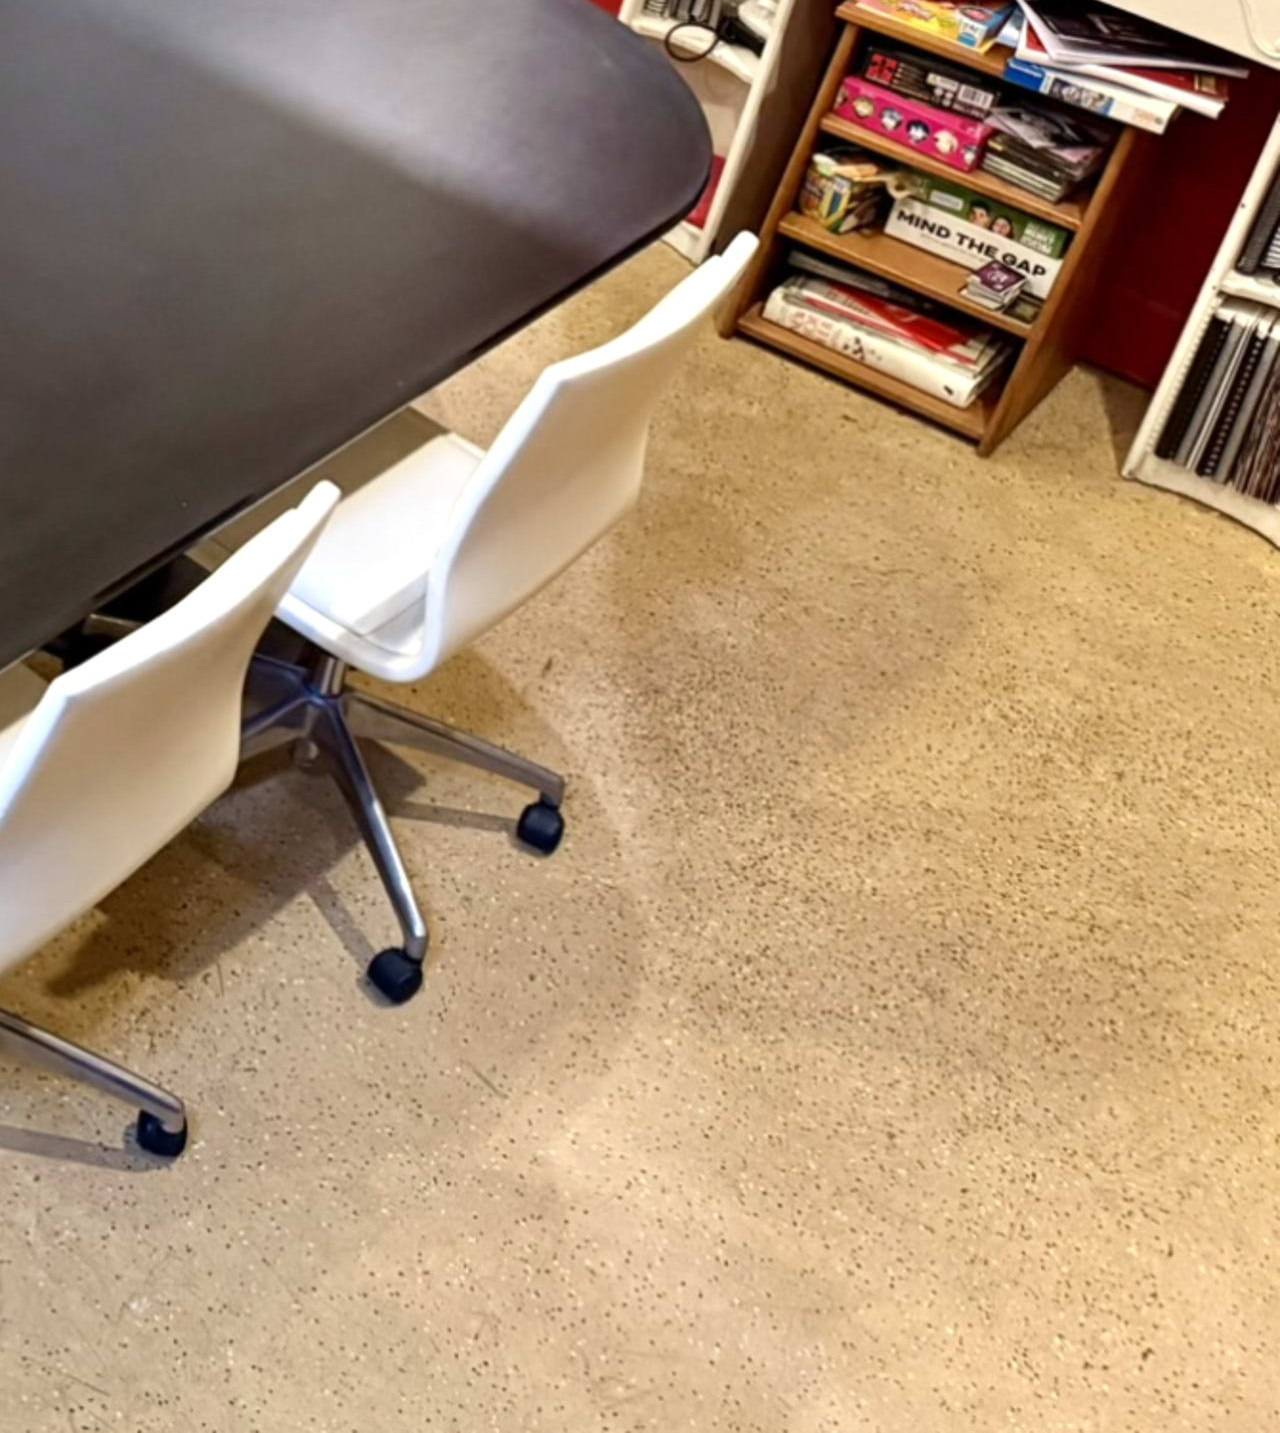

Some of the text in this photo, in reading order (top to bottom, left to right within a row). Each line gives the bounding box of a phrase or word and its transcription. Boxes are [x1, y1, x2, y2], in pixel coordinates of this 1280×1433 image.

[896, 210, 952, 239] MIND
[956, 232, 1000, 260] THE
[1001, 253, 1047, 278] GAP
